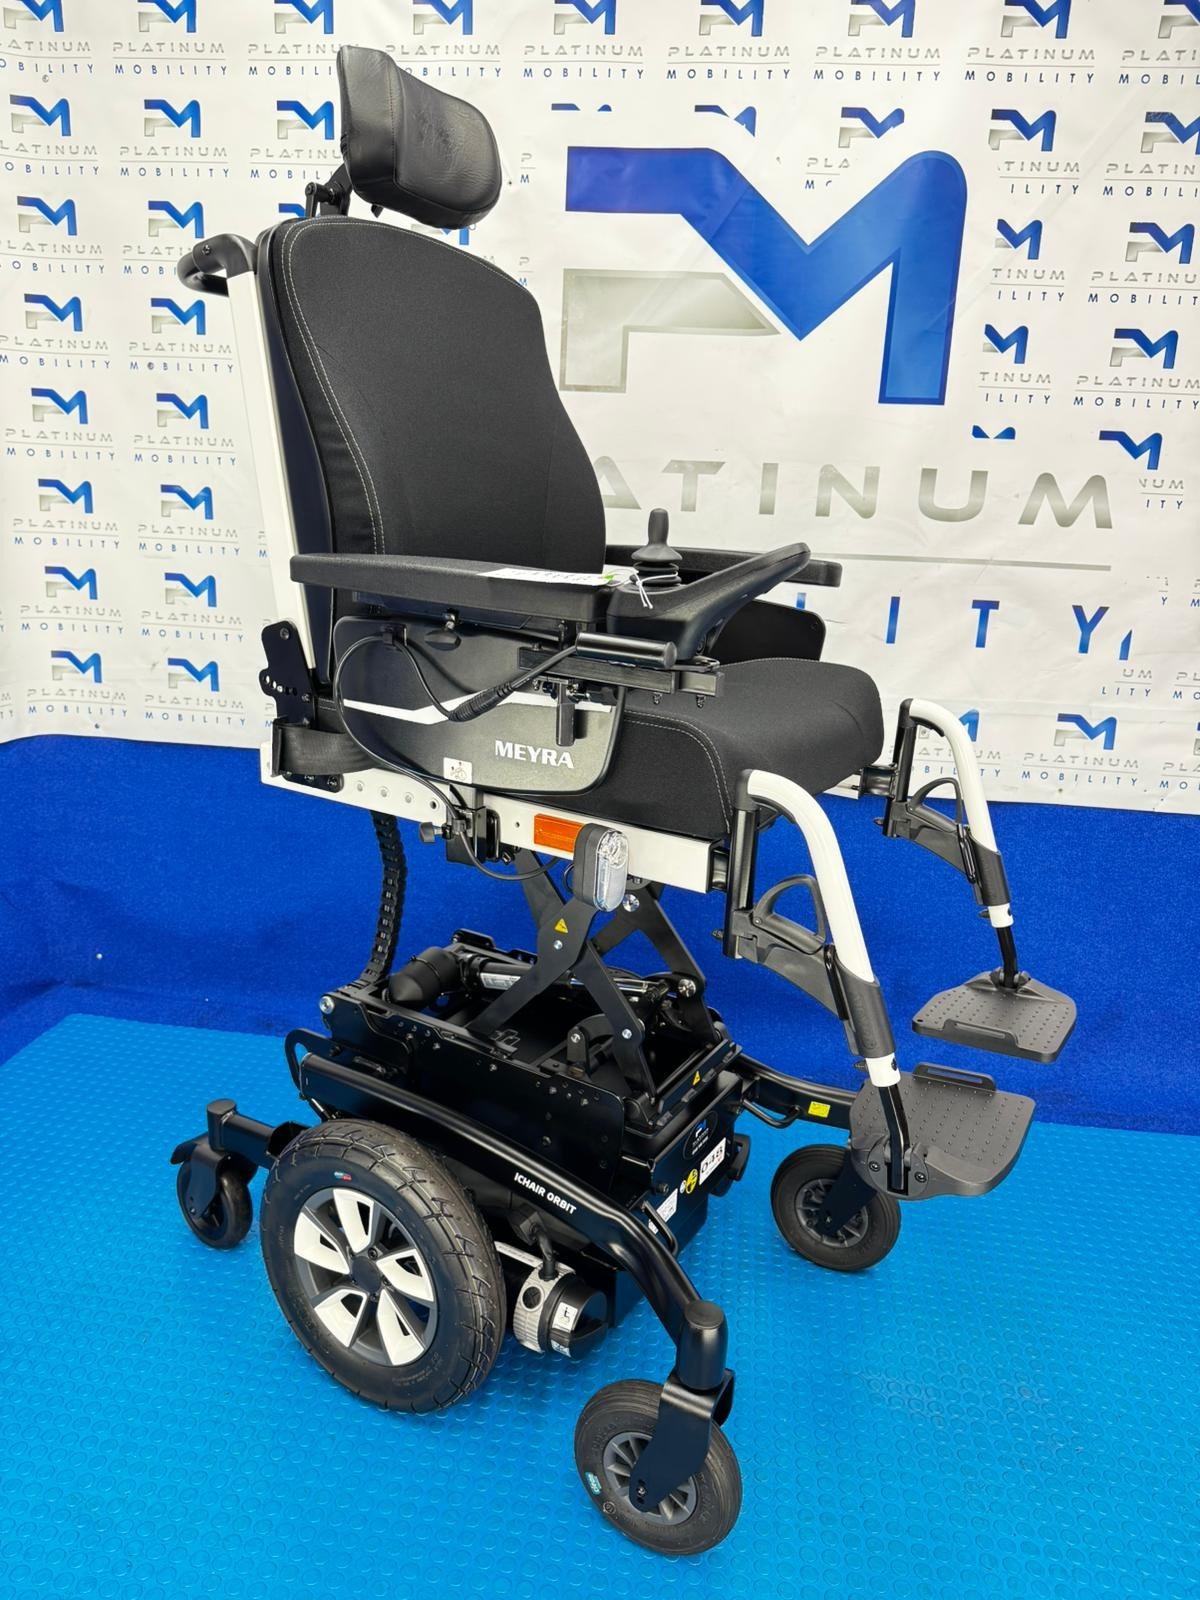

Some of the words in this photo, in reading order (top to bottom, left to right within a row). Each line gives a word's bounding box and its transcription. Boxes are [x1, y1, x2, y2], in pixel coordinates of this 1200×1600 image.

[8, 40, 90, 51] ATINUM
[113, 42, 224, 53] PLATINUM
[248, 44, 342, 54] PLATINU
[384, 44, 500, 55] PLATINUM
[524, 45, 643, 56] PLATINUM
[668, 46, 789, 57] PLATINUM
[816, 46, 940, 59] PLATINUM
[968, 47, 1095, 60] PLATINUM
[1122, 49, 1200, 61] PLATI
[0, 57, 93, 74] OBILITY
[115, 64, 226, 76] MOBILITY
[249, 66, 331, 76] MOBILI
[404, 67, 501, 76] OBILITY
[524, 68, 643, 80] MOBILITY
[667, 69, 790, 80] MOBILITY
[814, 70, 940, 82] MOBILITY
[965, 70, 1094, 84] MOBILITY
[1119, 74, 1200, 86] MOBIL
[0, 140, 97, 155] LATINUM
[120, 146, 227, 156] PLATINUM
[250, 148, 341, 159] PLATINU
[5, 160, 99, 176] OBILITY
[998, 161, 1080, 172] TINUM
[1106, 163, 1195, 175] PLATIN
[121, 168, 228, 178] MOBILITY
[250, 169, 320, 180] MOBIL
[1103, 186, 1198, 198] MOBILI
[5, 240, 102, 254] LATINUM
[123, 245, 184, 255] PLATI
[12, 260, 104, 274] OBILITY
[124, 265, 176, 275] MOBI
[1091, 271, 1197, 284] PLATINU
[1088, 293, 1198, 305] MOBILIT
[0, 335, 108, 348] PLATINUM
[129, 342, 231, 354] PLATINUM
[0, 354, 110, 369] MOBILITY
[130, 362, 233, 373] MOBILITY
[1075, 375, 1200, 389] PLATINUM
[1074, 396, 1199, 410] MOBILITY
[5, 428, 112, 442] PLATINUM
[134, 435, 234, 447] PLATINUM
[7, 446, 114, 461] MOBILITY
[135, 452, 235, 466] MOBILITY
[593, 456, 1113, 529] ATINUM
[13, 518, 117, 532] PLATINUM
[138, 524, 238, 538] PLATINUM
[15, 537, 119, 549] MOBILITY
[139, 542, 239, 555] MOBILITY
[21, 605, 121, 618] PLATINUM
[142, 611, 241, 624] PLATINUM
[22, 622, 123, 633] MOBILITY
[142, 629, 243, 642] MOBILITY
[27, 689, 125, 701] PLATINUM
[145, 695, 243, 709] PLATINUM
[29, 705, 127, 716] MOBILITY
[146, 712, 245, 726] MOBILITY
[495, 740, 575, 769] MEYRA
[917, 745, 1000, 761] ATIUM
[1023, 753, 1138, 768] PLATINUM
[925, 765, 1000, 777] BILTY
[1022, 770, 1137, 786] MOBILITY
[514, 1171, 546, 1197] ICHAIR
[547, 1192, 577, 1214] ORBIT
